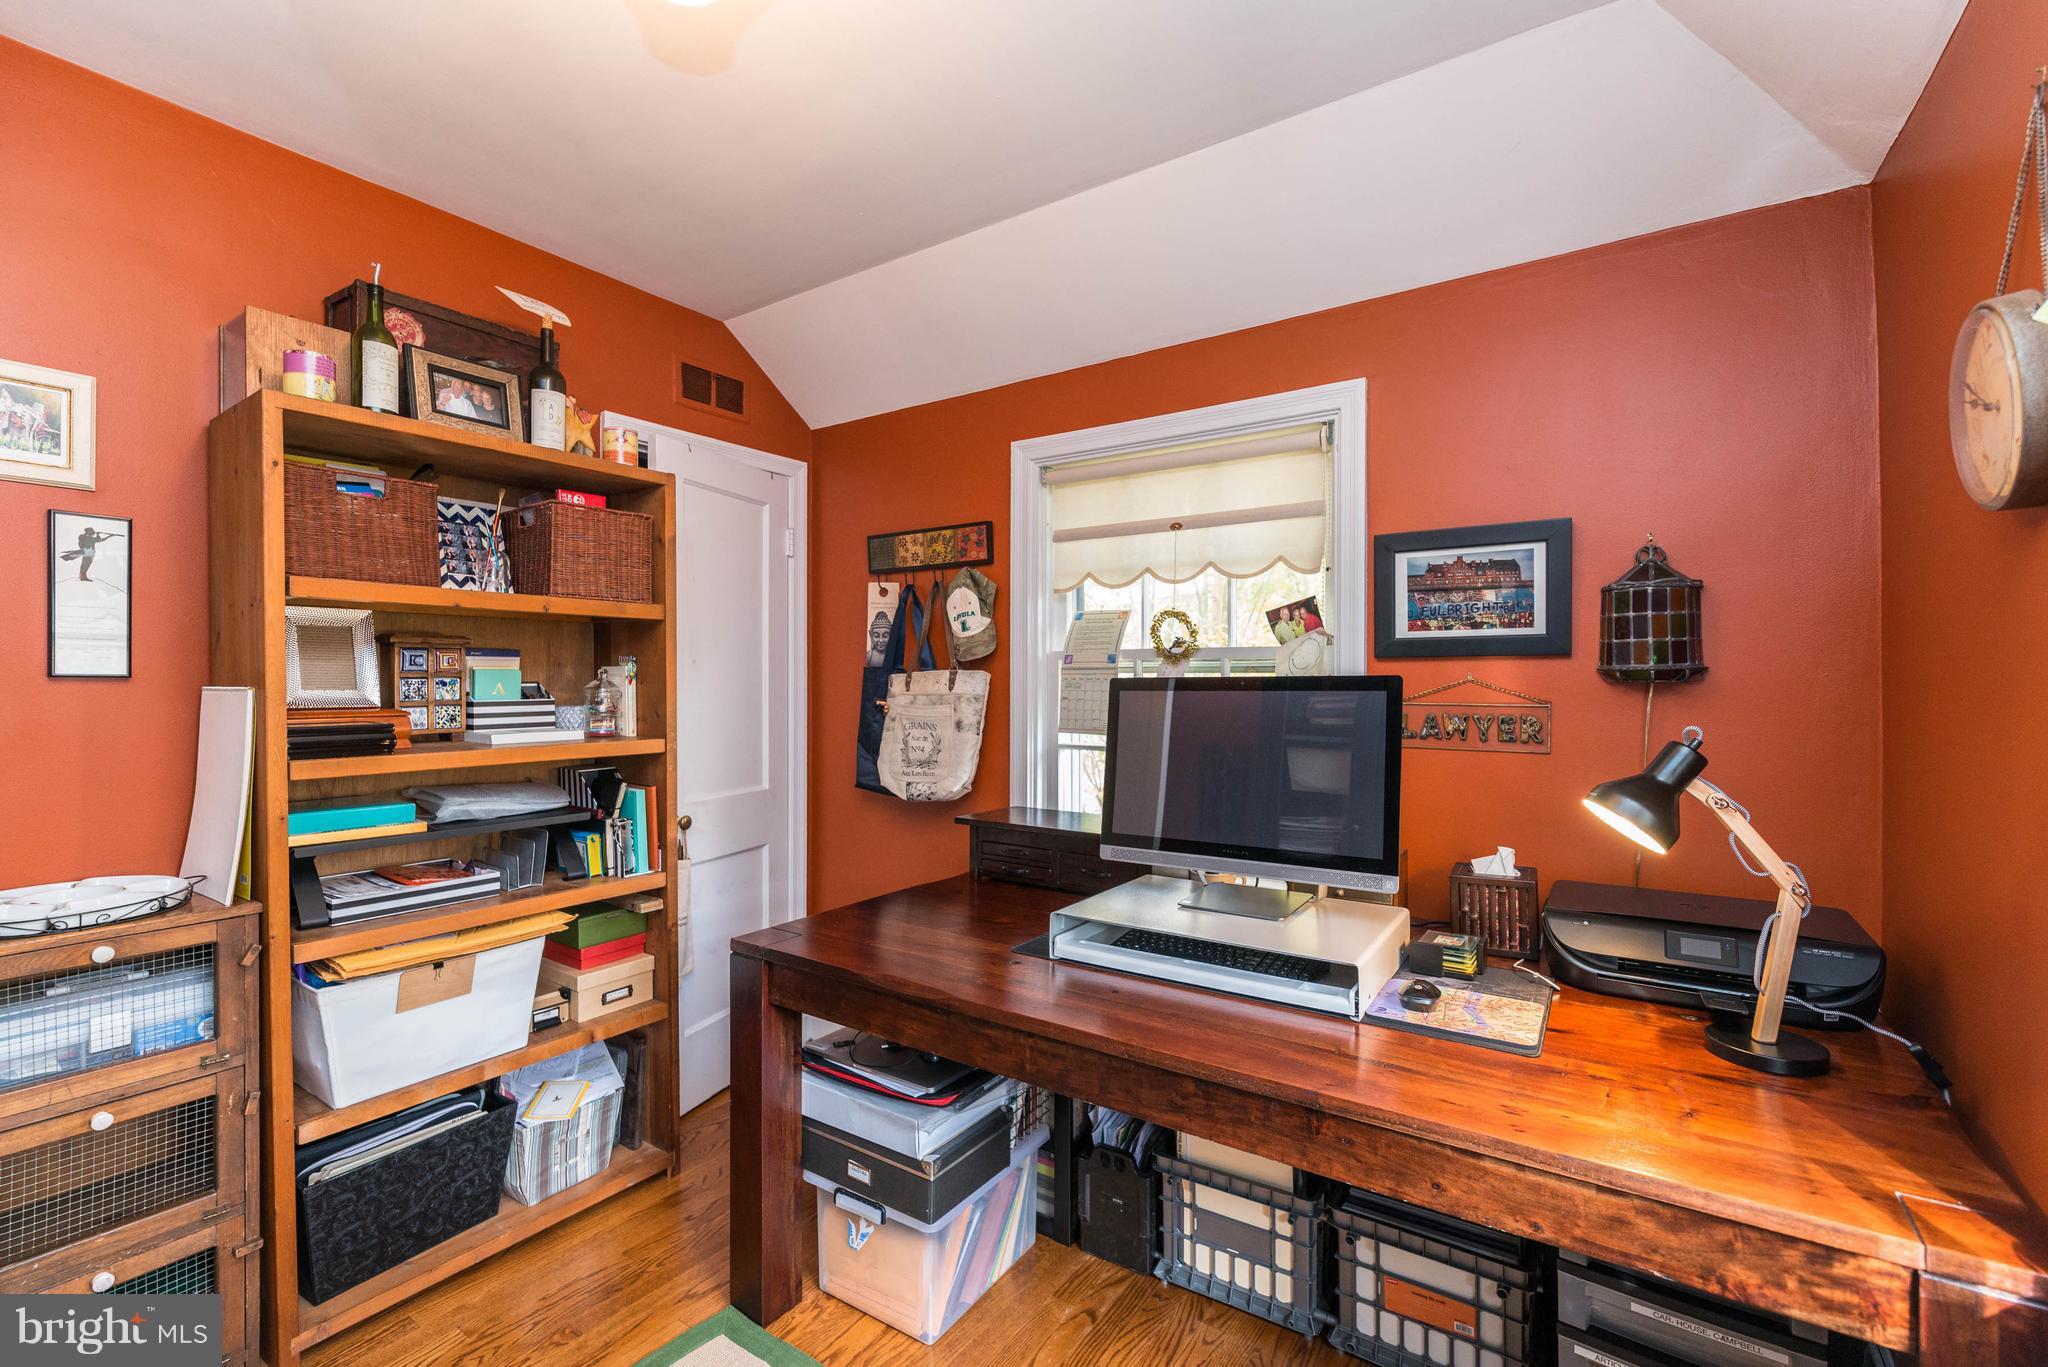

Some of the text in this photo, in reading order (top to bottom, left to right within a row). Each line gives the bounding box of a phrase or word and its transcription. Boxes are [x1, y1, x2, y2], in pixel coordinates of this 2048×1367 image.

[1421, 601, 1502, 617] FULBRIGHT
[904, 721, 938, 732] GRAINS
[1401, 713, 1544, 744] LAWYER
[1713, 1332, 1764, 1355] CAMPBELL
[1594, 1353, 1625, 1367] ARTIC
